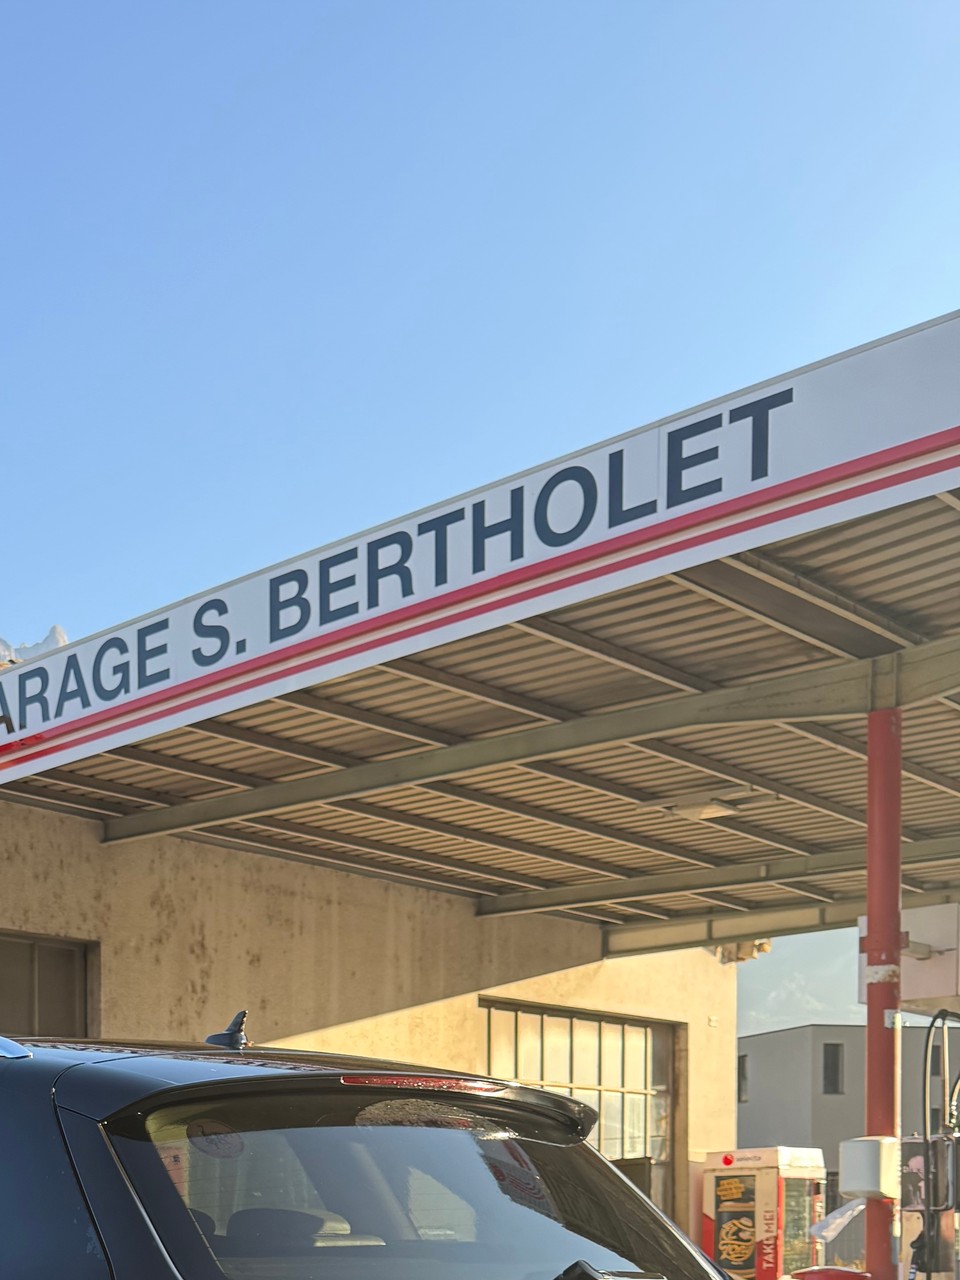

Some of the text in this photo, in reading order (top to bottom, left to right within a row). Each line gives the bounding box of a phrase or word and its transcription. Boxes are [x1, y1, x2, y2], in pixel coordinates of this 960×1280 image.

[191, 598, 247, 668] S.
[269, 387, 794, 644] BERTHOLET
[762, 1236, 776, 1270] TAKE
